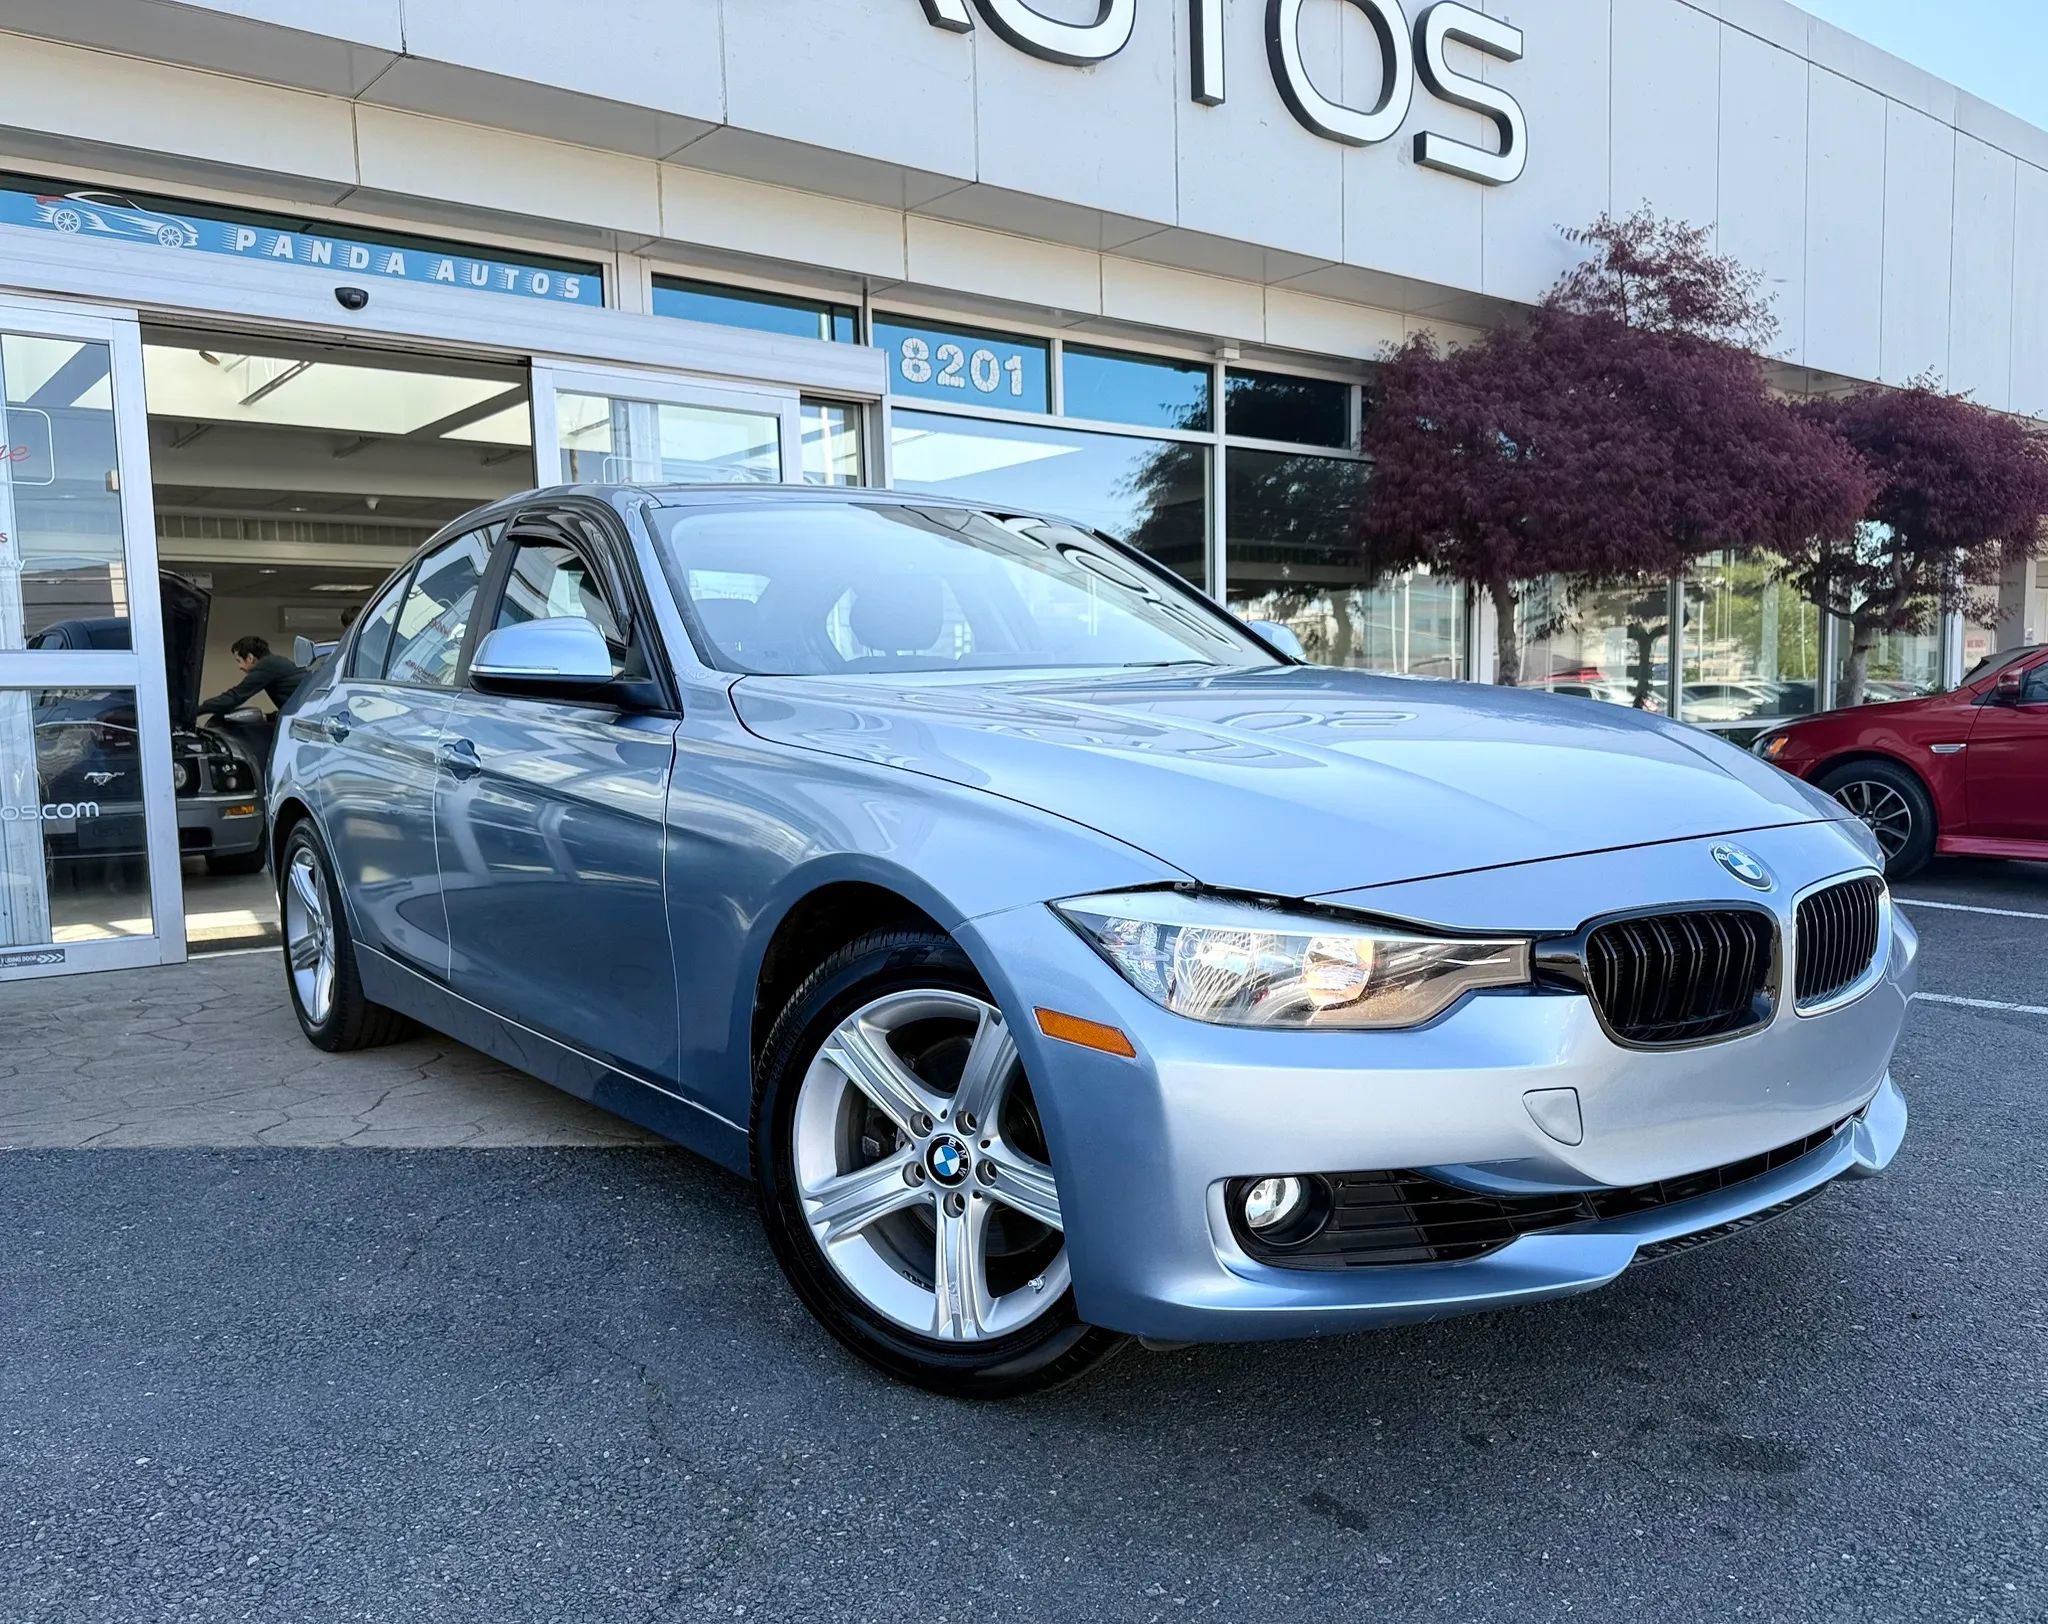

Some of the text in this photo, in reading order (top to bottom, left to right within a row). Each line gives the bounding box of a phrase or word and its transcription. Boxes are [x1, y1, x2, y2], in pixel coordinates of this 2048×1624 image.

[233, 227, 581, 299] PANDA AUTOS
[901, 337, 1023, 396] 8201
